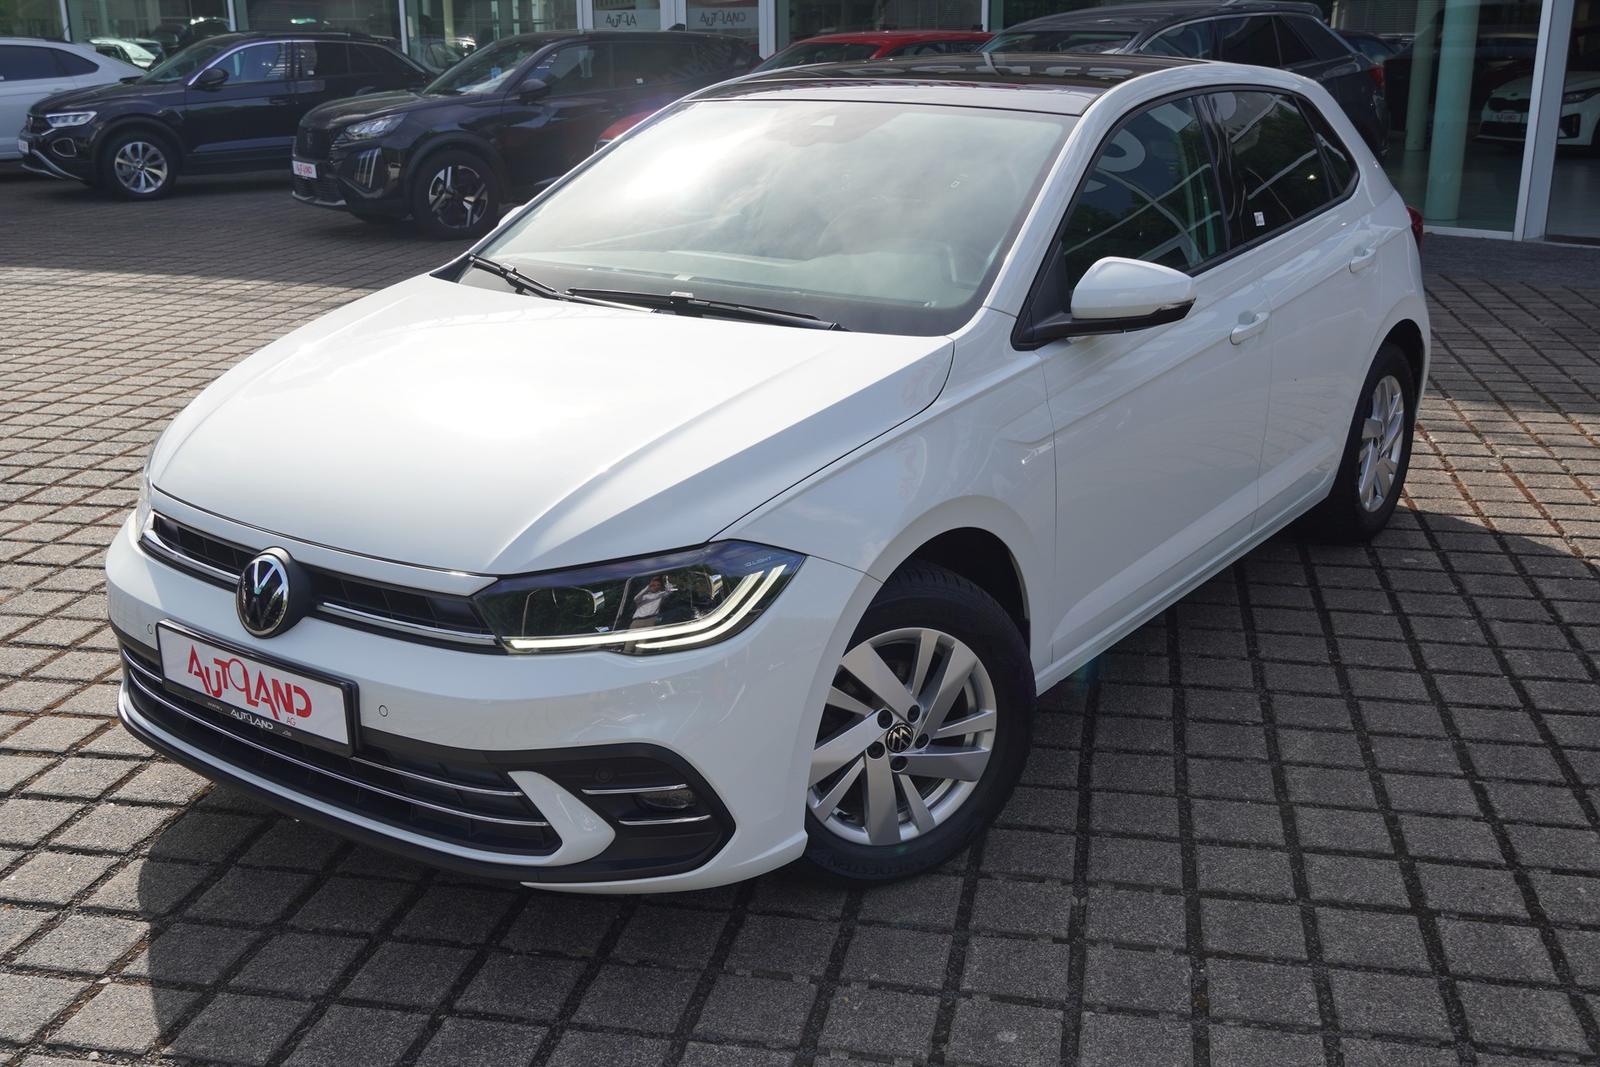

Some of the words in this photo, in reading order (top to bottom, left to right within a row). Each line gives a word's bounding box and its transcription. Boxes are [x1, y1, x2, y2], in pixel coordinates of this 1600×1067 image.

[187, 645, 312, 721] AUTOLAND
[230, 709, 274, 730] AUTOLAND
[286, 716, 297, 727] AG
